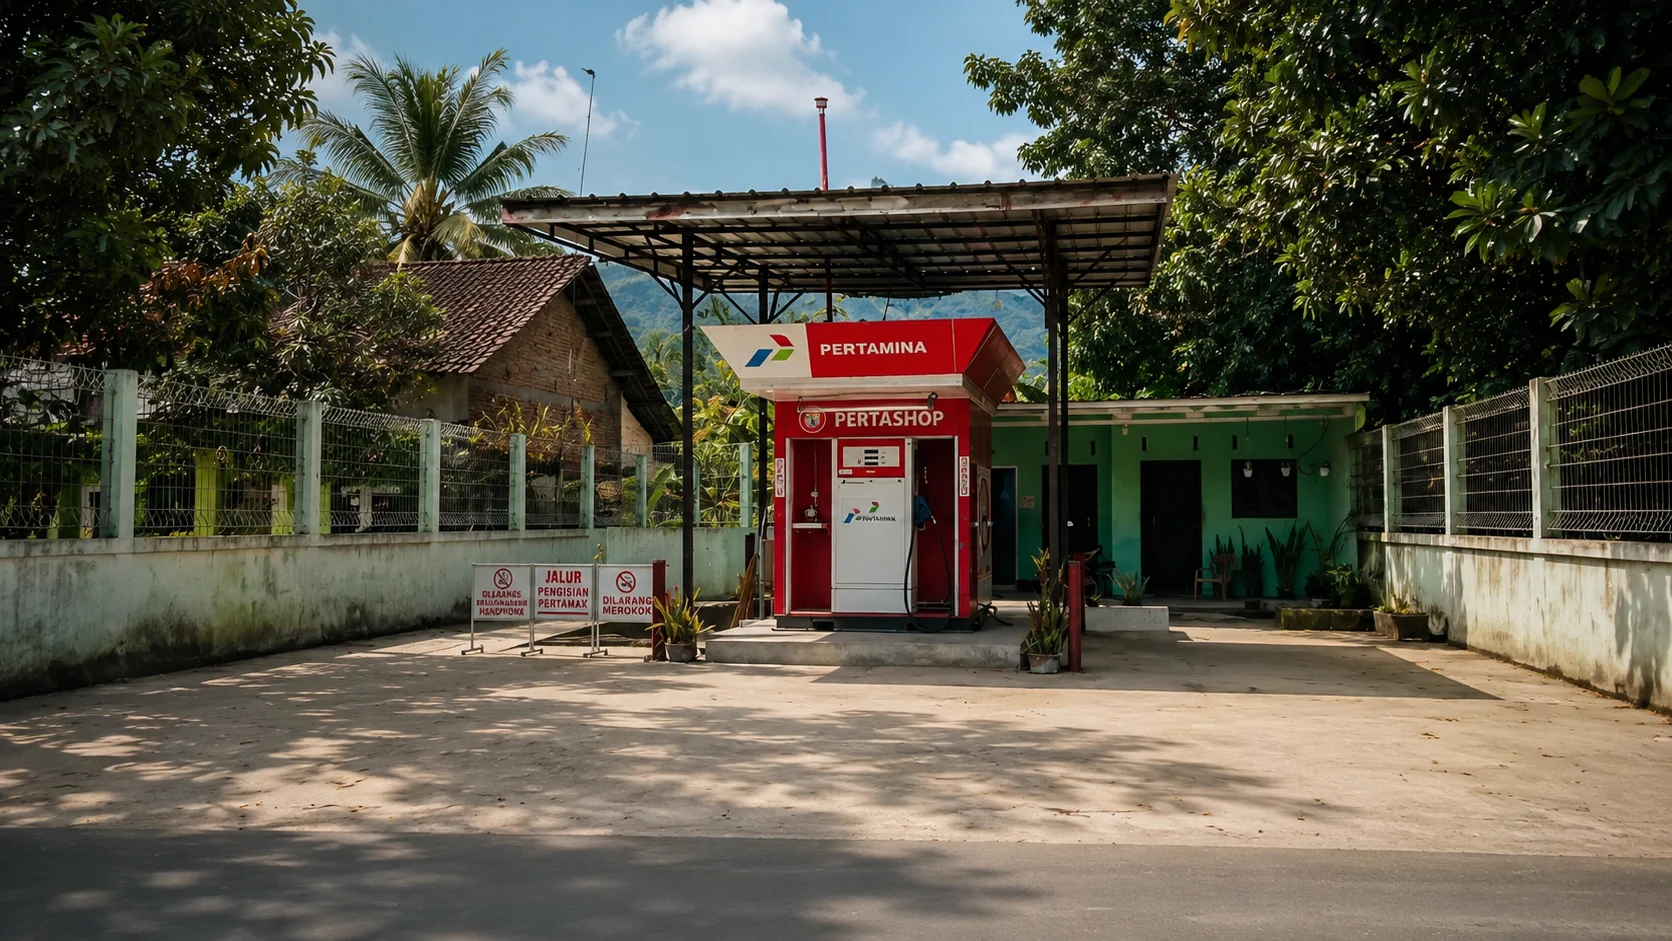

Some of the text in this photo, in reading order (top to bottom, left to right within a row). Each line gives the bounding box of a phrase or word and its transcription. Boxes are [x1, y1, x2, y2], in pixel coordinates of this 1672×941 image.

[820, 341, 927, 355] PERTAMINA
[835, 410, 944, 427] PERTASHOP
[545, 570, 582, 584] JALUR
[538, 587, 589, 597] PENGISIAN
[538, 599, 588, 608] PERTAMAX
[603, 596, 652, 605] DILARANG
[602, 606, 652, 615] MEROKOK
